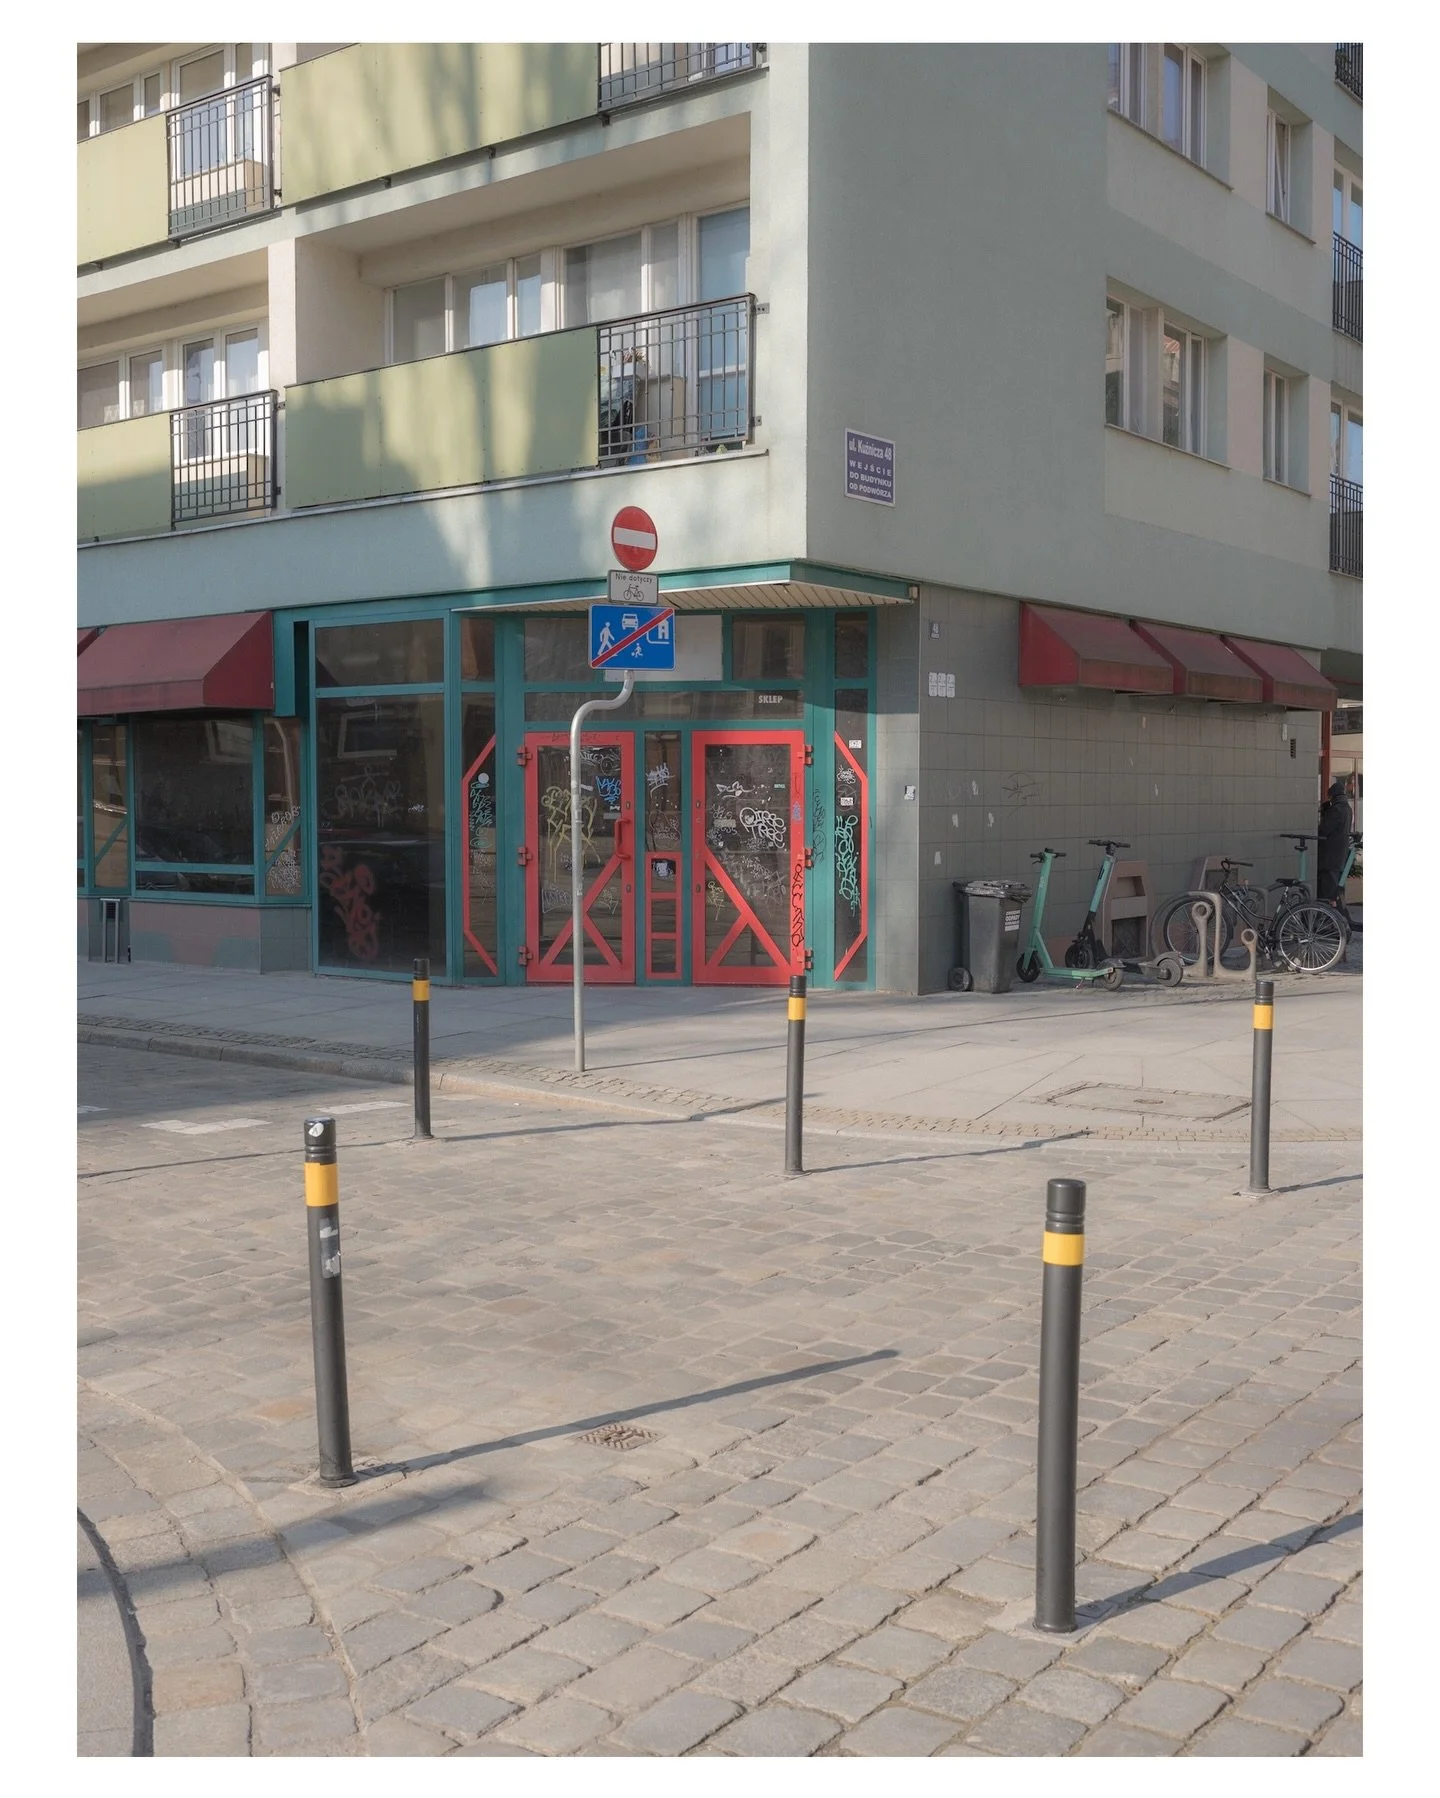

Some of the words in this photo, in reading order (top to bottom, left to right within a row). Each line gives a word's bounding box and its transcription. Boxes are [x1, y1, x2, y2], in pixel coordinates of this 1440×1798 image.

[858, 439, 884, 459] Kuźnicza
[849, 459, 892, 477] WEJŚCIE
[849, 471, 859, 480] DO
[860, 474, 892, 486] BUDYNKU
[849, 482, 858, 490] OD
[615, 573, 627, 582] Nie
[628, 574, 652, 584] dotyczy
[758, 695, 783, 704] SKLEP
